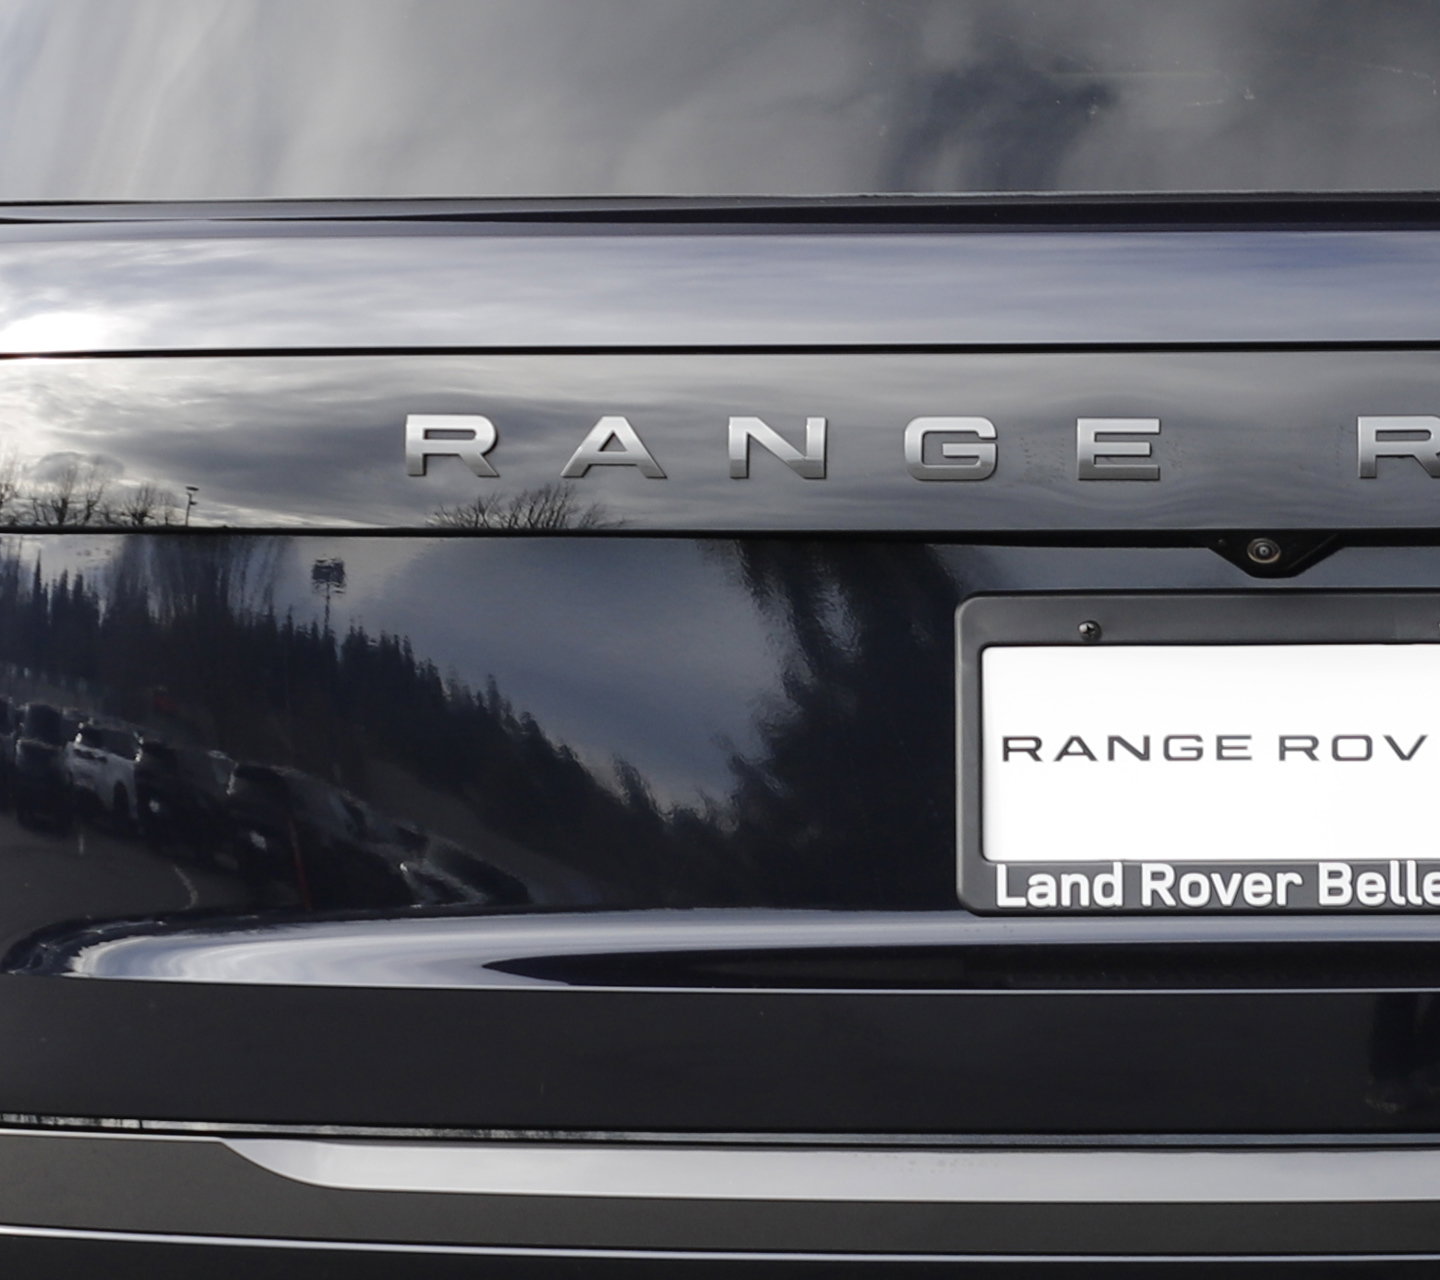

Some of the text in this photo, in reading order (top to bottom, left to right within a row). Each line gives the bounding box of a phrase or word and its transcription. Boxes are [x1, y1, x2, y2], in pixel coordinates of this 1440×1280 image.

[404, 412, 1162, 481] RANGE
[1000, 733, 1254, 763] RANGE
[995, 860, 1124, 909] Land
[1141, 862, 1304, 909] Rover
